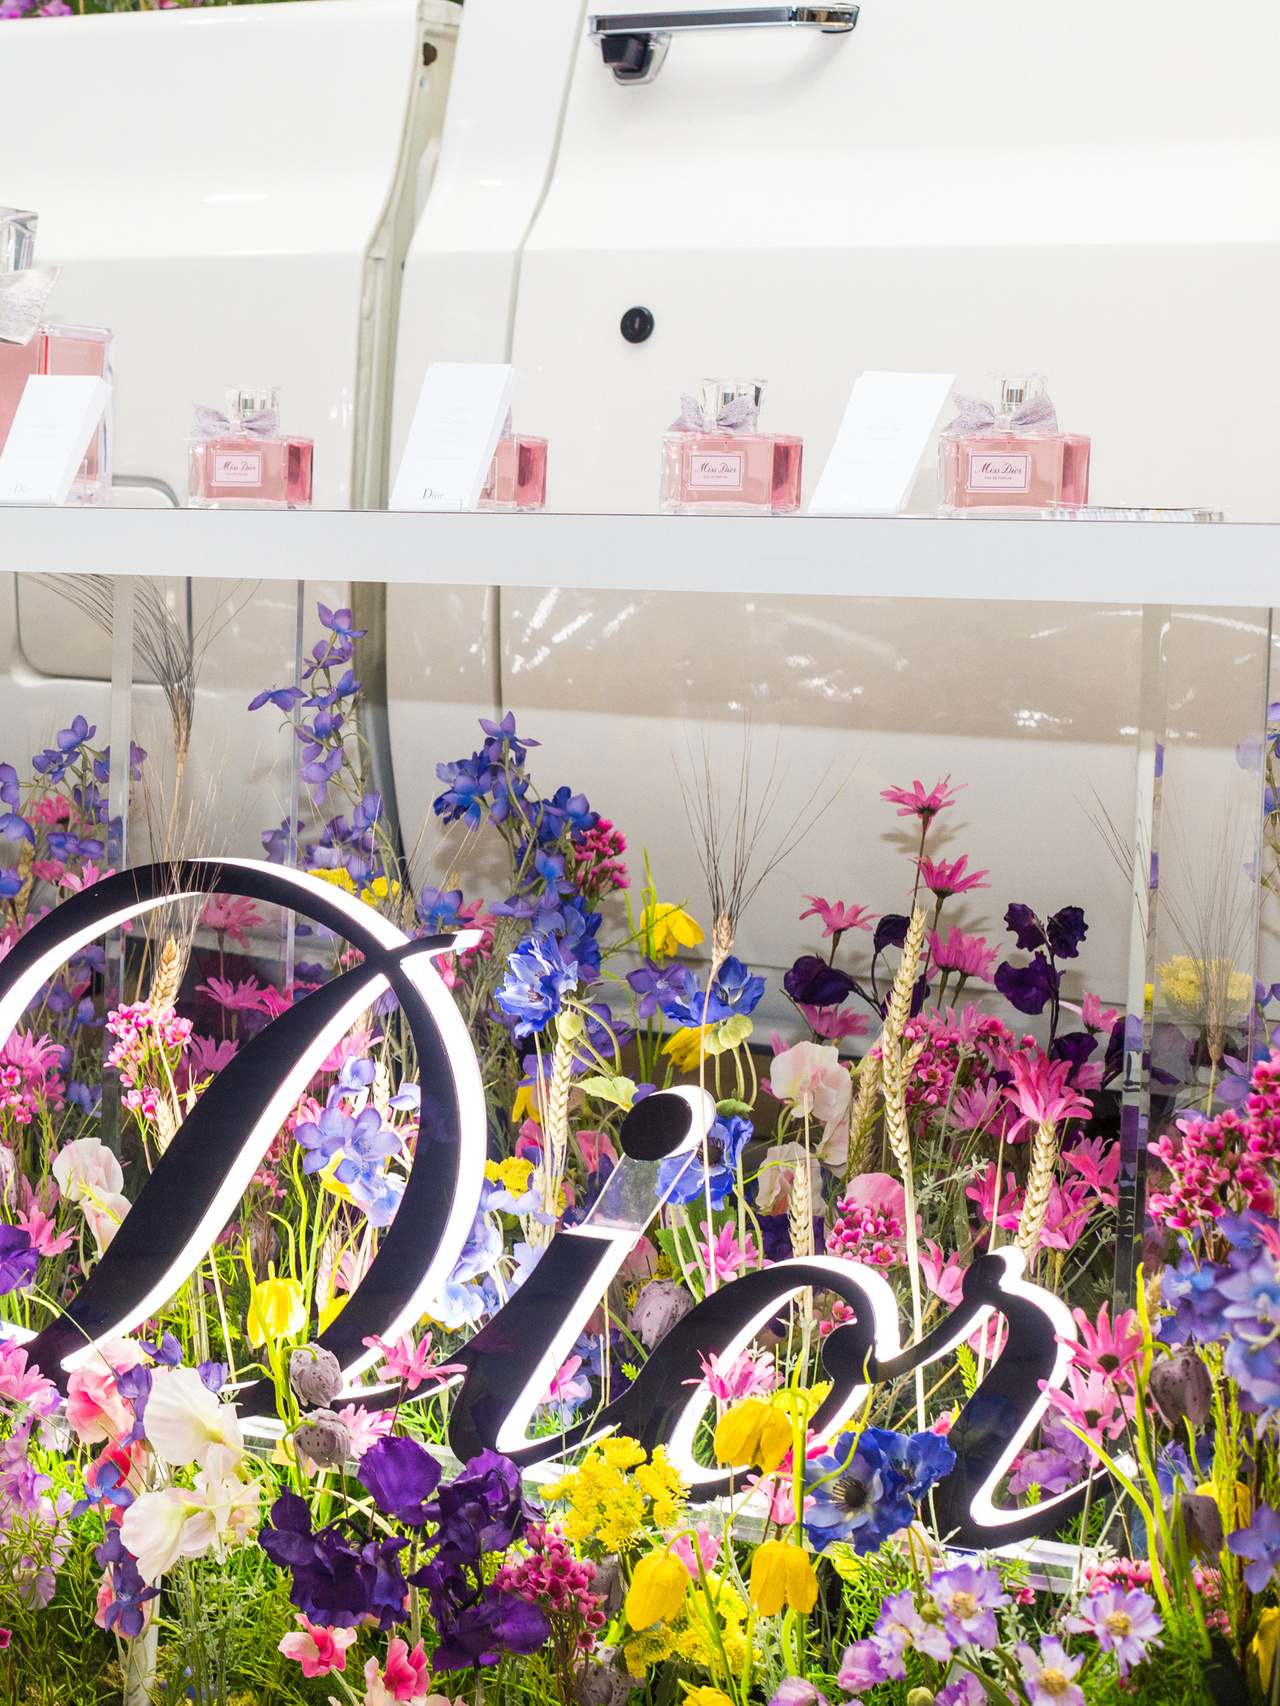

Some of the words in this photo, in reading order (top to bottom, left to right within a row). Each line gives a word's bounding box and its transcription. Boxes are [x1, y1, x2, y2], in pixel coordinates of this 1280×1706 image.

[218, 461, 238, 471] Miss
[239, 461, 256, 471] Dior
[694, 462, 717, 473] Miss
[718, 462, 737, 473] Dior
[974, 462, 1000, 474] Miss
[1001, 462, 1022, 474] Dior
[422, 488, 445, 500] Dior
